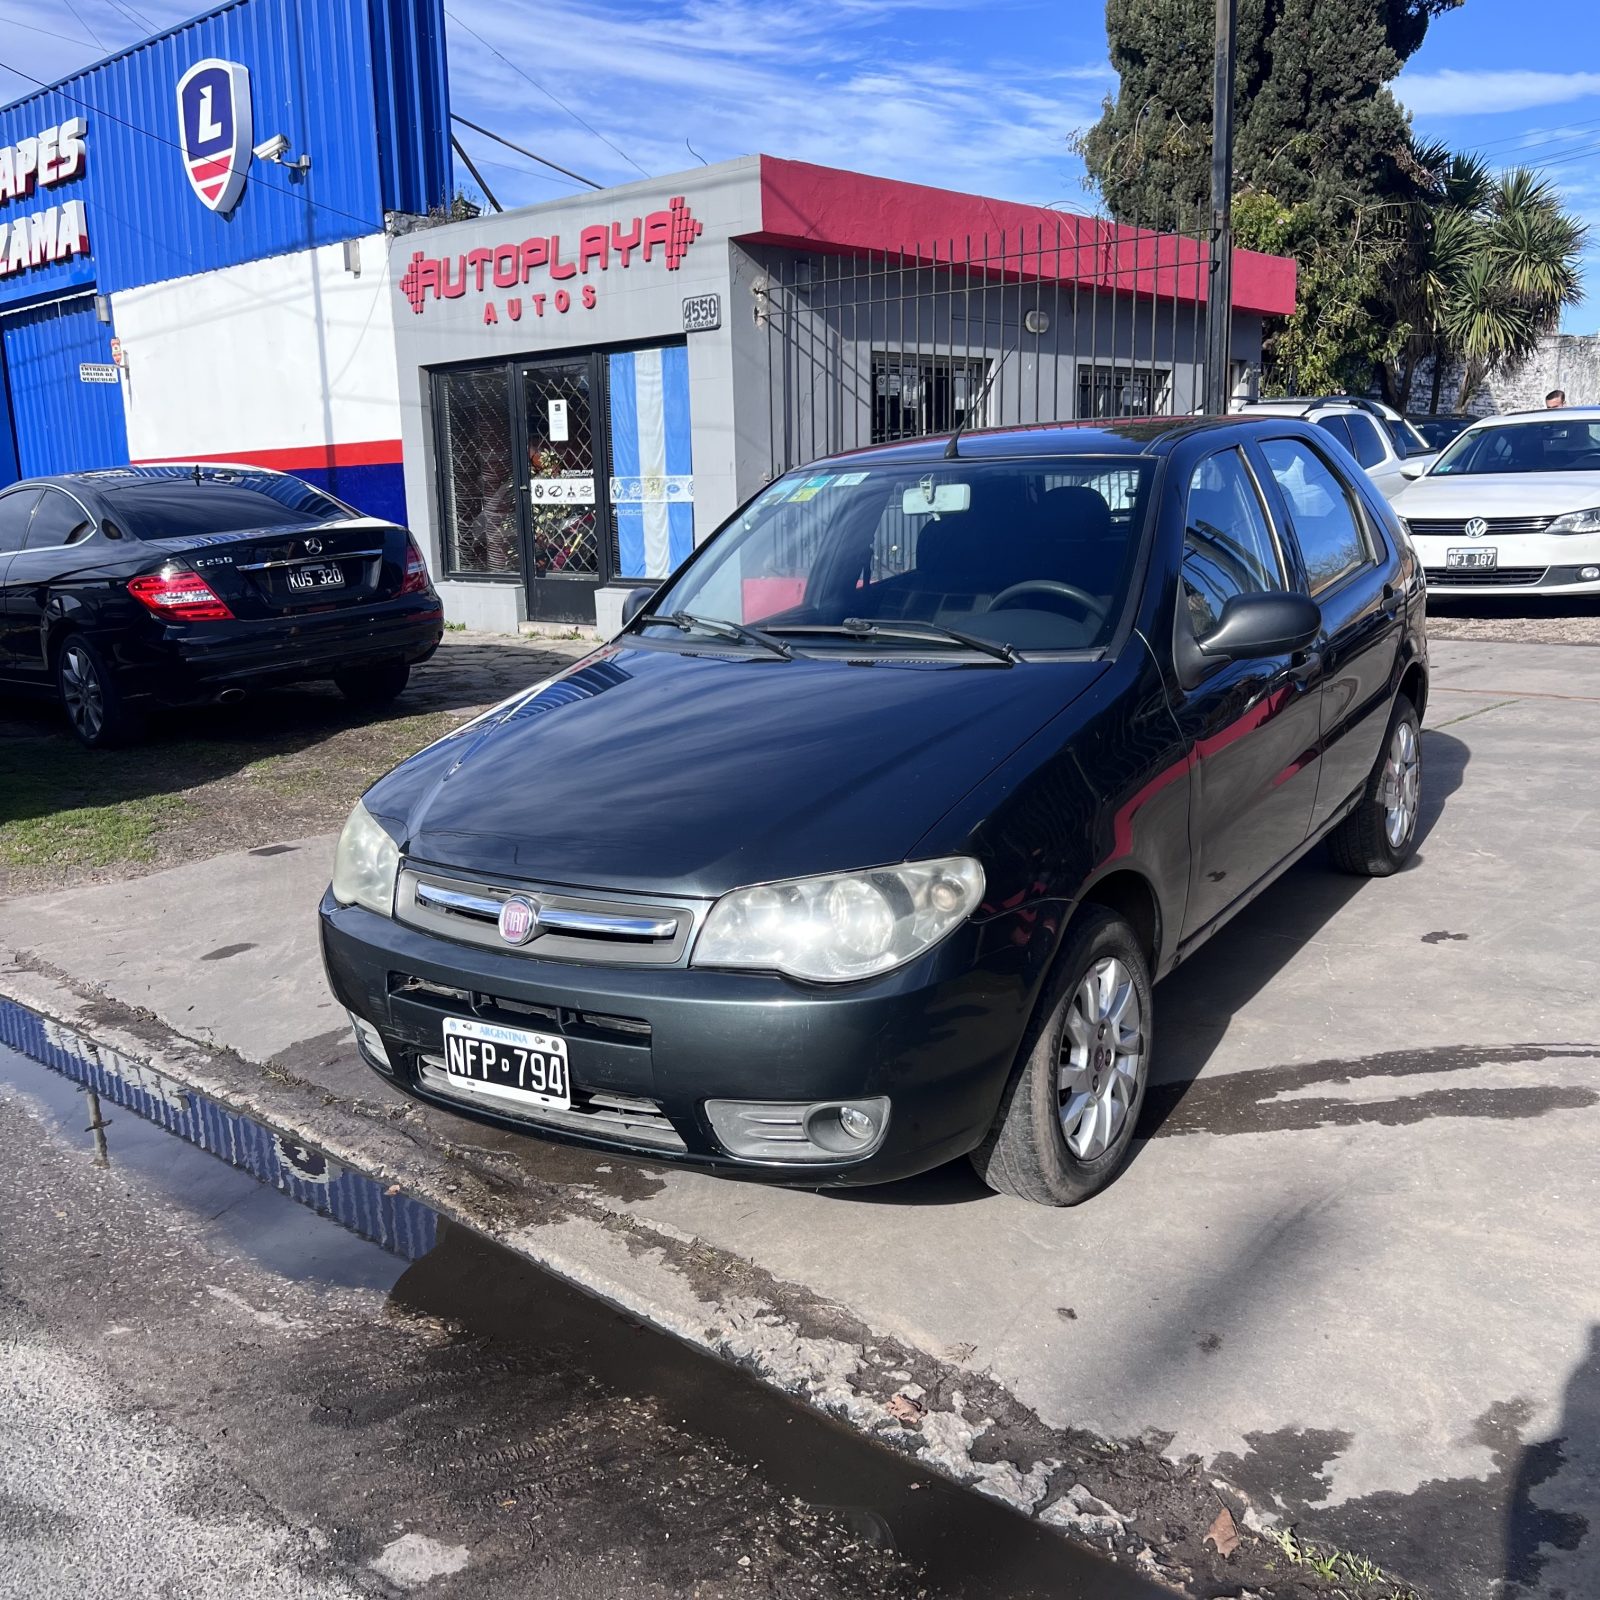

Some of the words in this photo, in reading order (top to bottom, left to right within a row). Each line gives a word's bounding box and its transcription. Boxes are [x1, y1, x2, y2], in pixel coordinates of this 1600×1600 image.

[198, 84, 222, 144] L
[417, 210, 675, 300] AUTOPLAYA
[483, 284, 597, 325] AUTOS
[684, 298, 716, 323] 4550
[196, 559, 204, 567] C
[206, 556, 233, 566] 250
[1449, 554, 1468, 566] NFI
[1474, 553, 1494, 566] 187
[289, 573, 314, 588] KUS
[319, 568, 342, 585] 320
[505, 911, 527, 933] FIAT
[480, 1026, 528, 1044] ARGENTINA
[448, 1036, 497, 1080] NFP
[513, 1049, 563, 1095] 794
